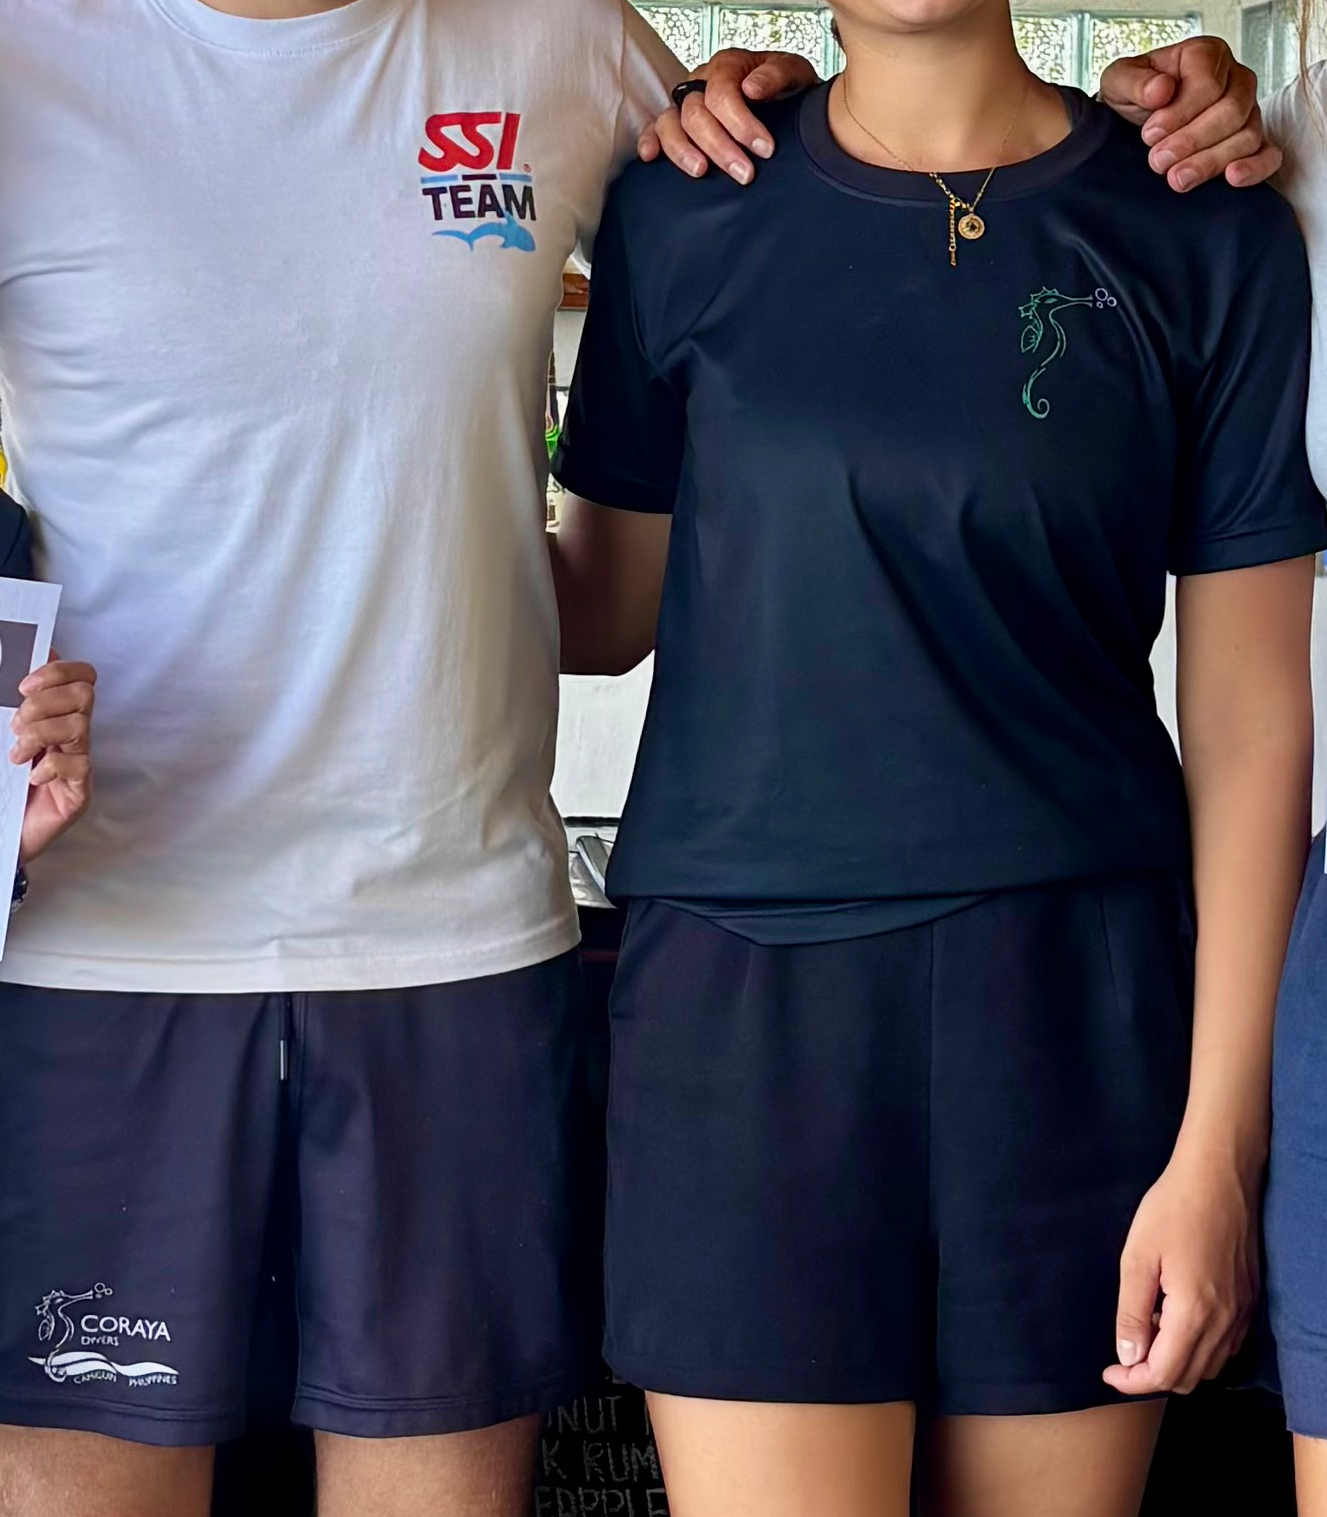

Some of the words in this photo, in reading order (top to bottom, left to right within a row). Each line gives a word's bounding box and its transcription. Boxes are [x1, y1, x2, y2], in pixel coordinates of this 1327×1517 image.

[418, 111, 521, 172] SSI
[422, 184, 536, 221] TEAM
[81, 1315, 171, 1341] CORAYA
